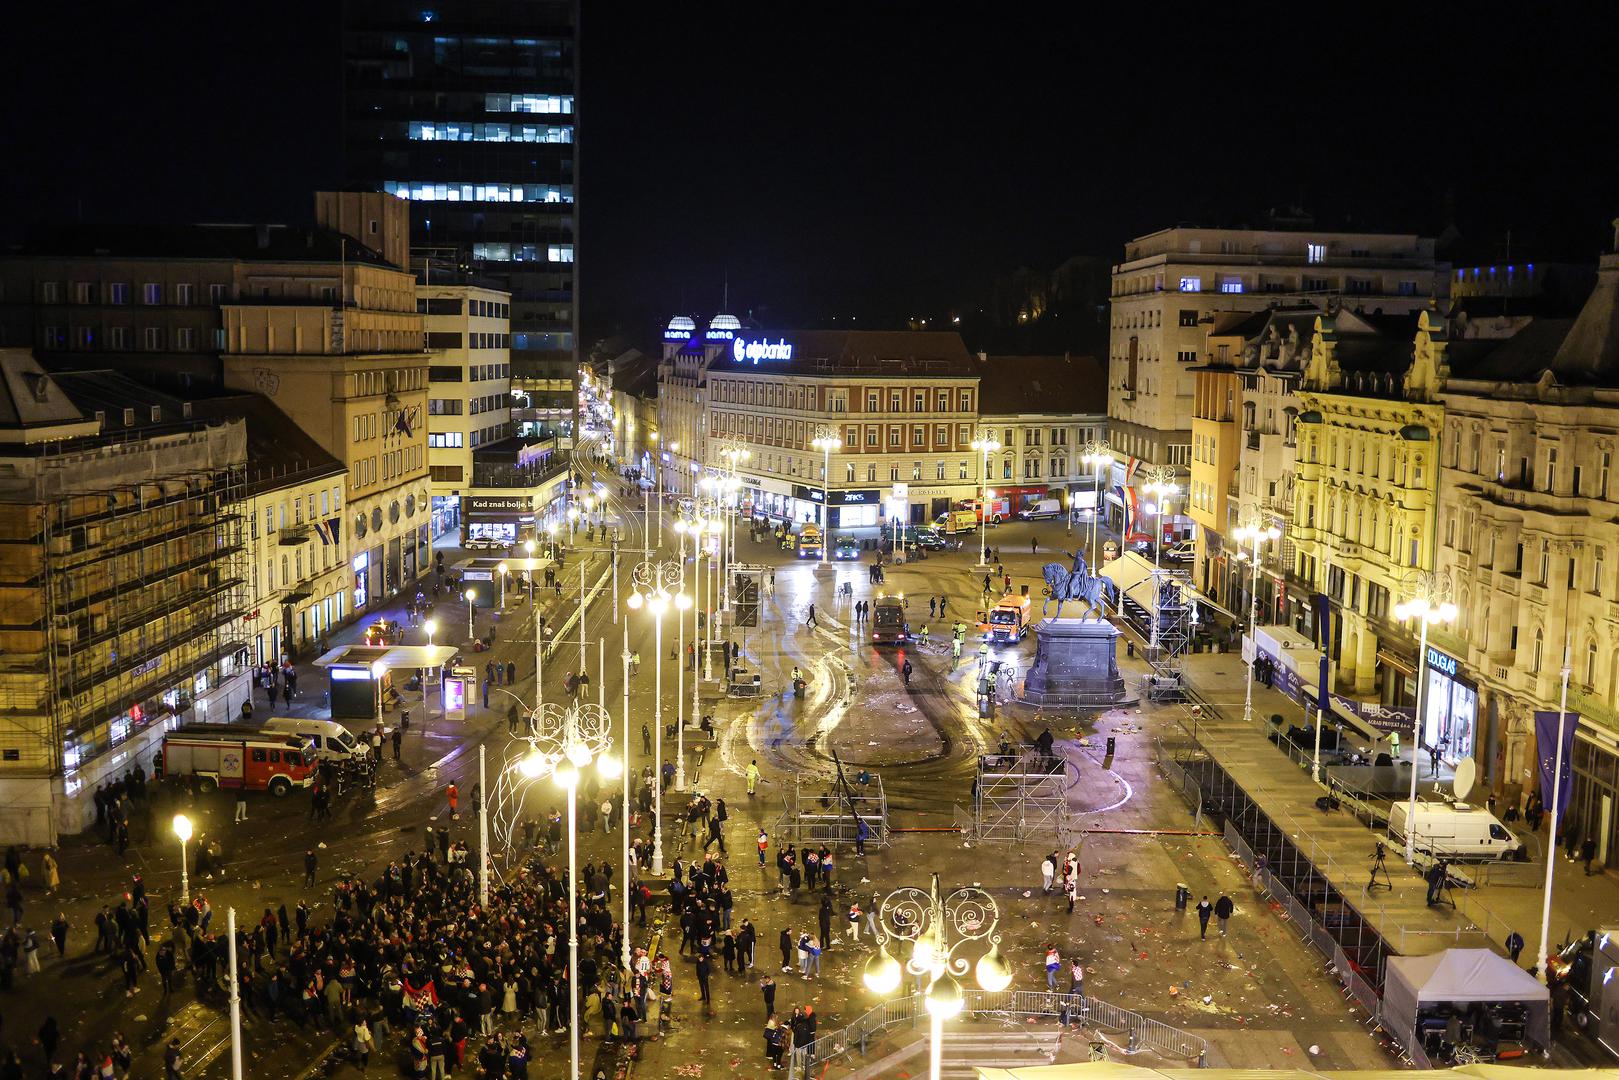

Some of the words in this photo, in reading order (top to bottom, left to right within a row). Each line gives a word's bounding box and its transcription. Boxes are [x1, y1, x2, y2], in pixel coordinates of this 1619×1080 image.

[489, 500, 506, 508] znaš
[506, 500, 527, 509] bolje,
[1427, 648, 1457, 676] DOUGLAS
